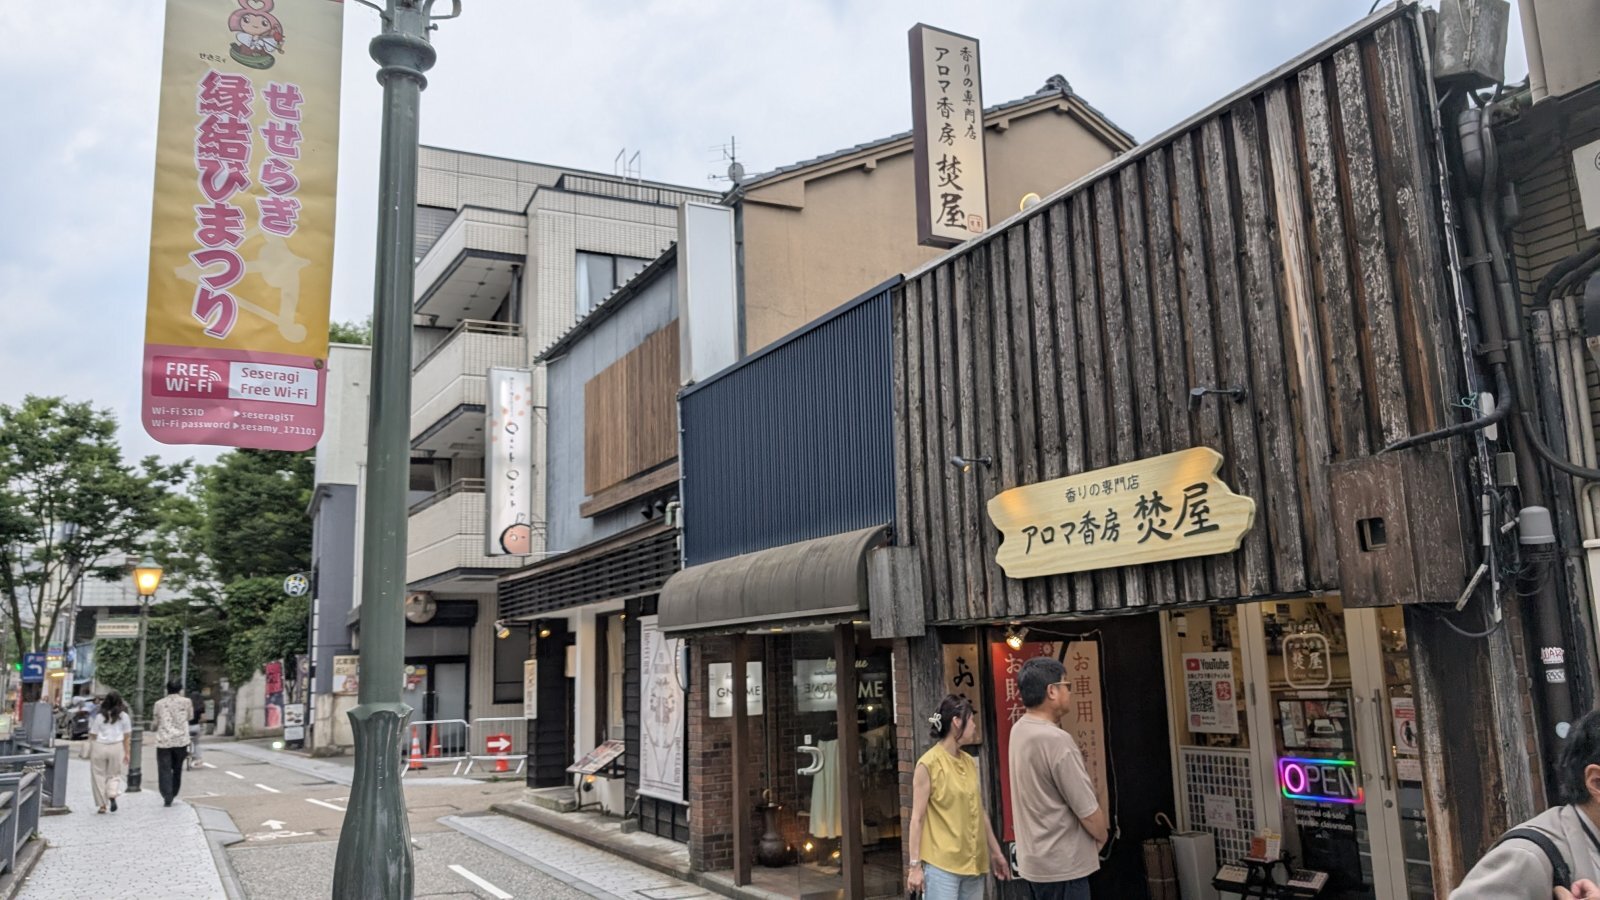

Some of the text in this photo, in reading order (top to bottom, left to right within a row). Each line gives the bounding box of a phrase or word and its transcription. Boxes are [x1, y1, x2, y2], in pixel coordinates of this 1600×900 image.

[959, 46, 977, 141] 香りの専門店
[934, 47, 968, 231] アロマ香房 焚屋
[257, 82, 305, 236] せせらぎ
[189, 70, 254, 339] 縁結びまつり
[166, 362, 209, 378] FREE
[241, 367, 300, 384] Seseragi
[165, 377, 212, 393] Wi-Fi
[240, 383, 308, 400] Free Wi-Fi
[151, 406, 205, 416] Wi-Fi SSID
[241, 411, 295, 422] seseragiST
[151, 419, 230, 430] Wi-Fi password
[240, 424, 317, 436] sesamy_171101
[1064, 474, 1140, 503] 香りの専門店
[1021, 482, 1220, 555] アロマ香房 焚屋
[1200, 658, 1230, 670] YouTube
[1073, 652, 1094, 722] お車用
[1284, 763, 1358, 797] OPEN
